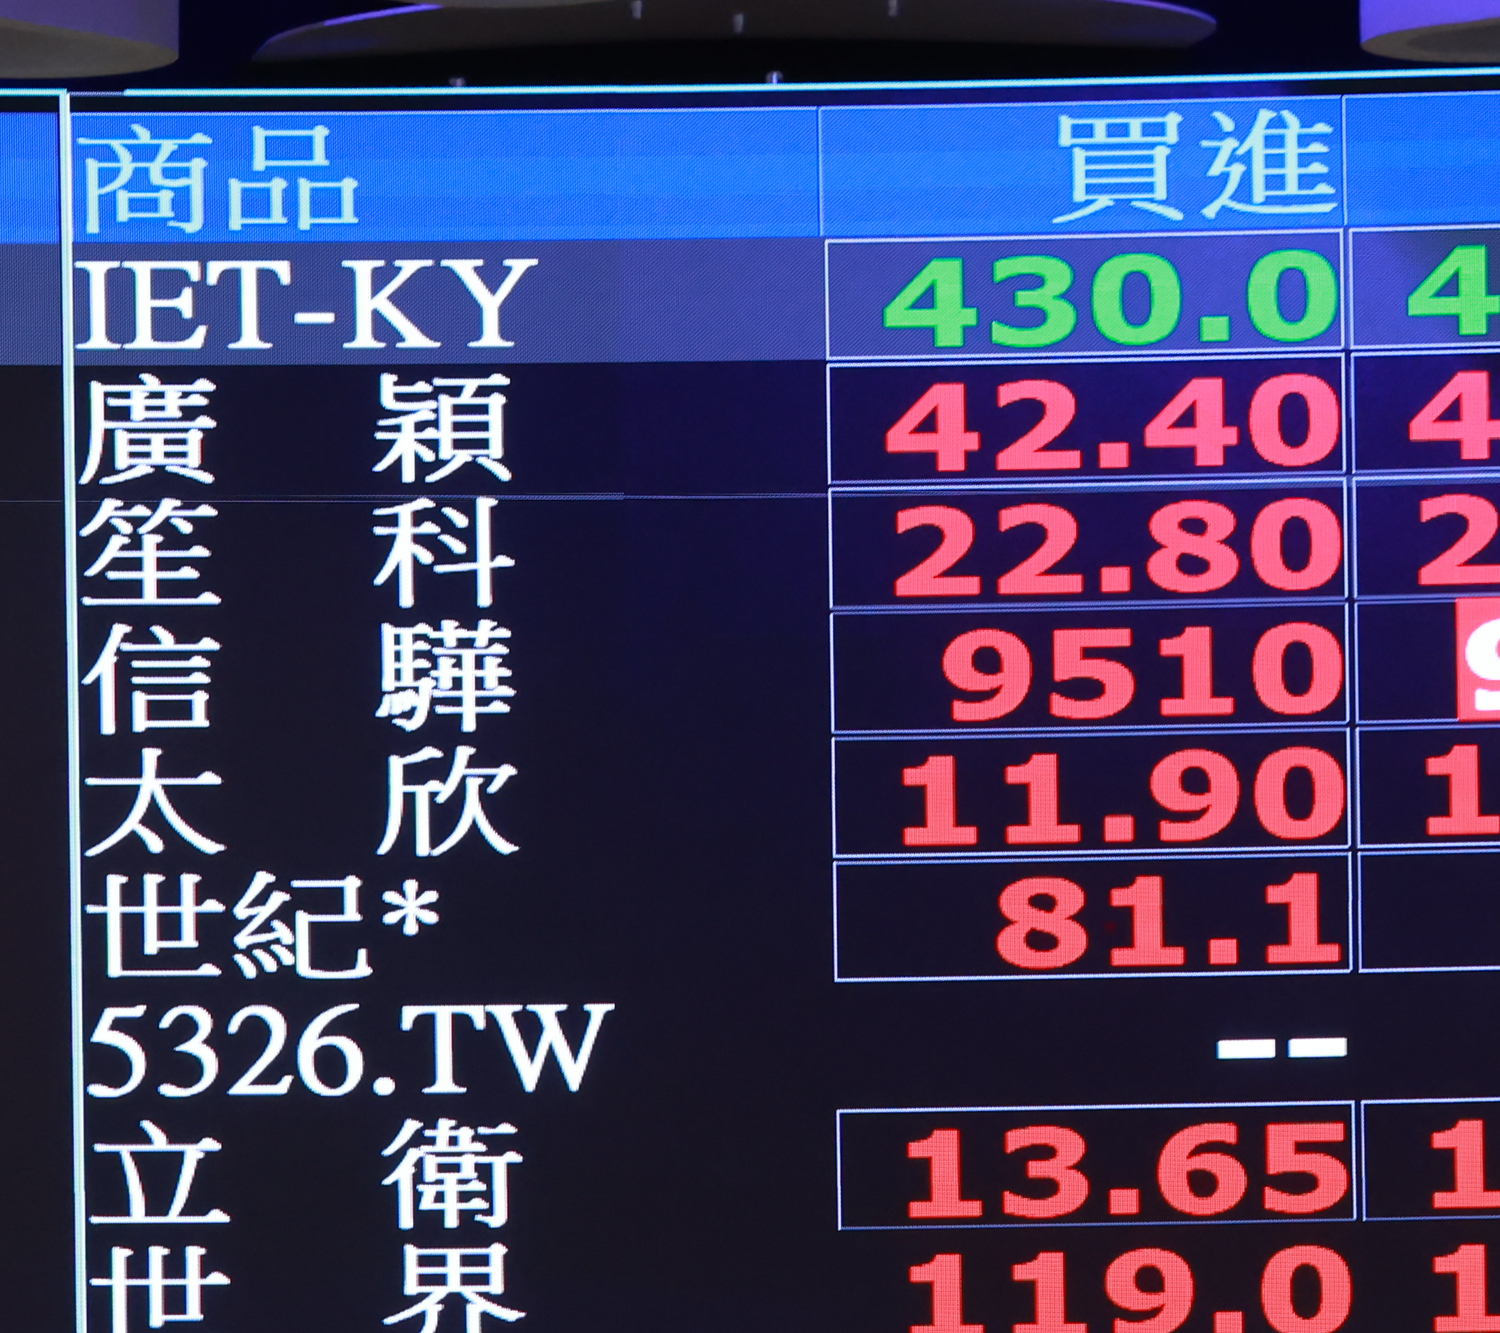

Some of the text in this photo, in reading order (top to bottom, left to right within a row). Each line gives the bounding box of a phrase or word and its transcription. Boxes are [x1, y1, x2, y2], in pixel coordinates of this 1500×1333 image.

[79, 125, 358, 233] 商品
[1053, 110, 1337, 222] 買進
[74, 257, 540, 352] IET-KY
[884, 250, 1337, 347] 430.0
[942, 622, 1344, 722] 9510
[89, 1004, 615, 1097] 5326.TW
